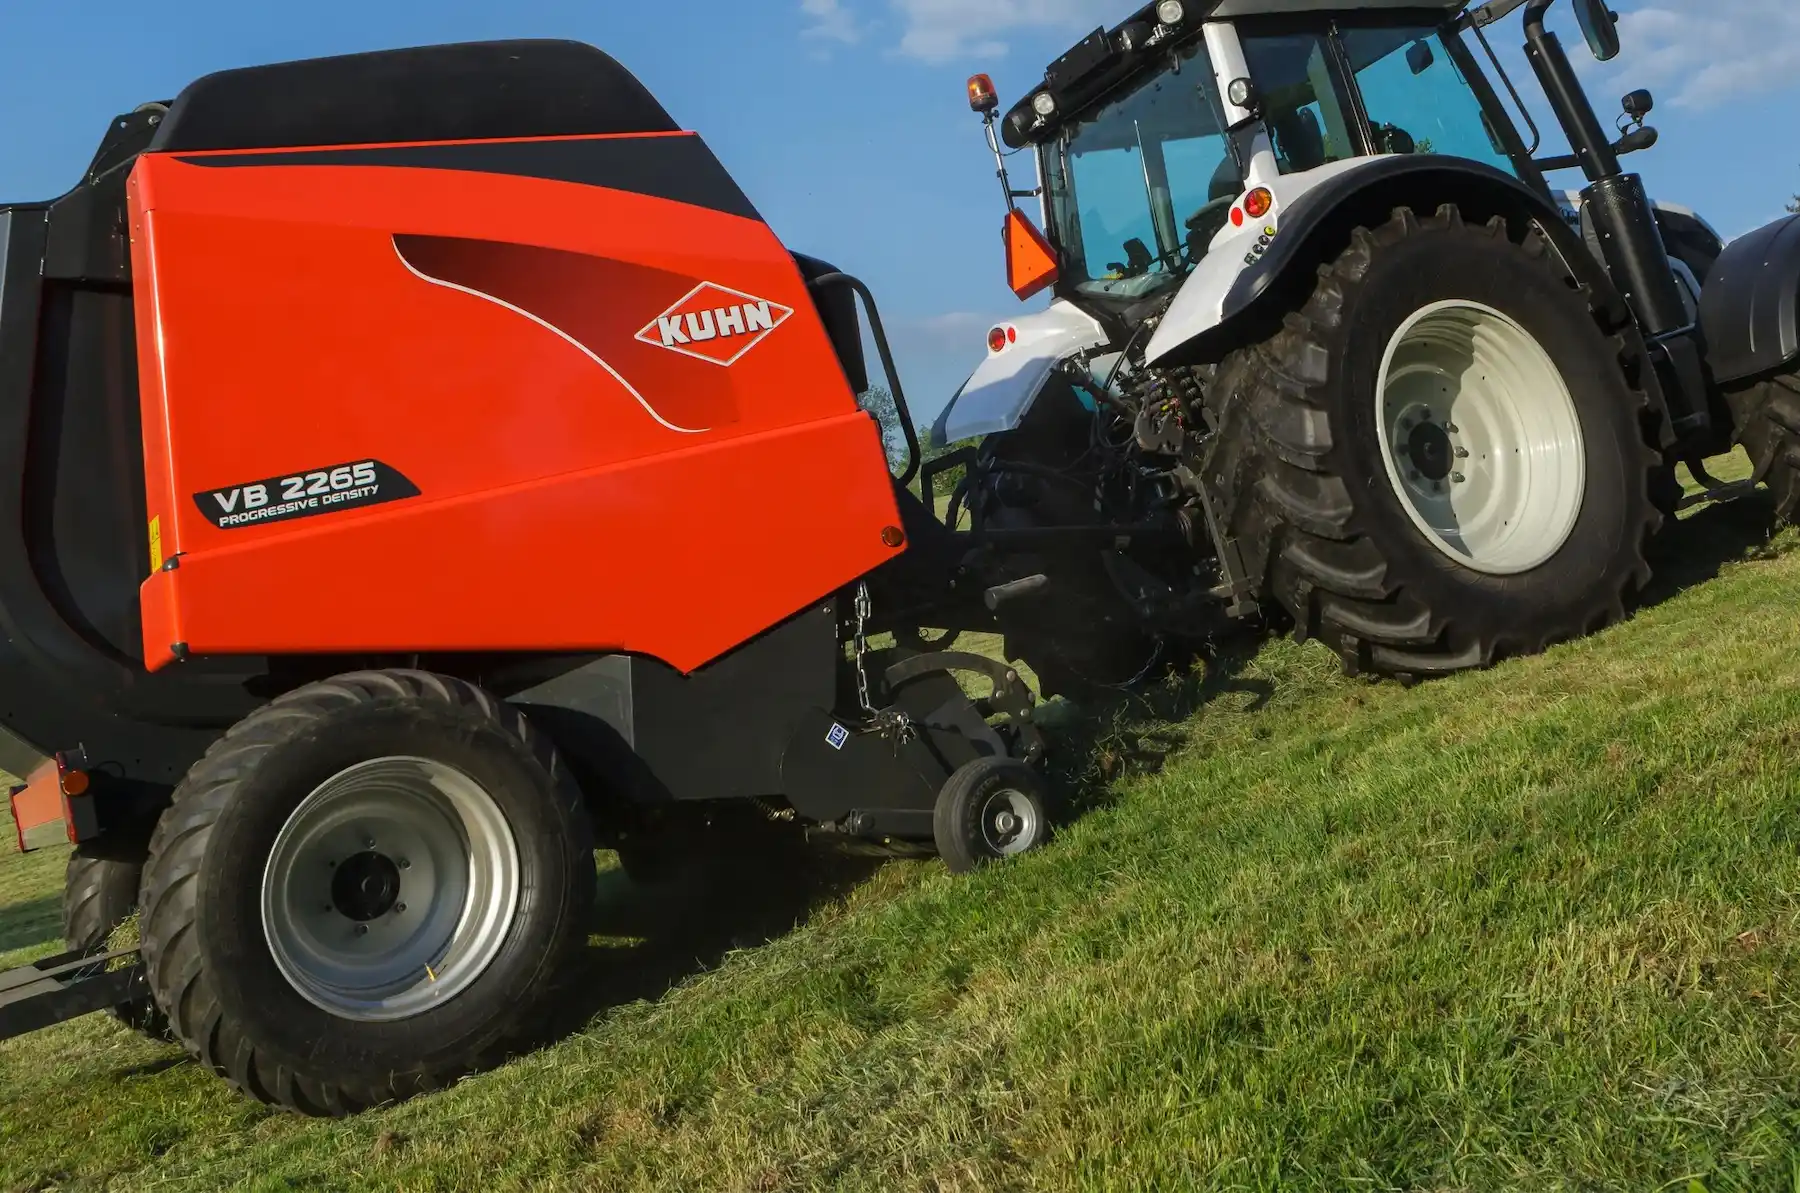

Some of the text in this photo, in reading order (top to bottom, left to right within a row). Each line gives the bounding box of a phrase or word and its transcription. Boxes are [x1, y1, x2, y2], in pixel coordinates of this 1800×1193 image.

[657, 300, 773, 347] KUHN
[212, 461, 377, 513] VB 2265
[219, 484, 379, 527] PROGRESSIVE DENSITY
